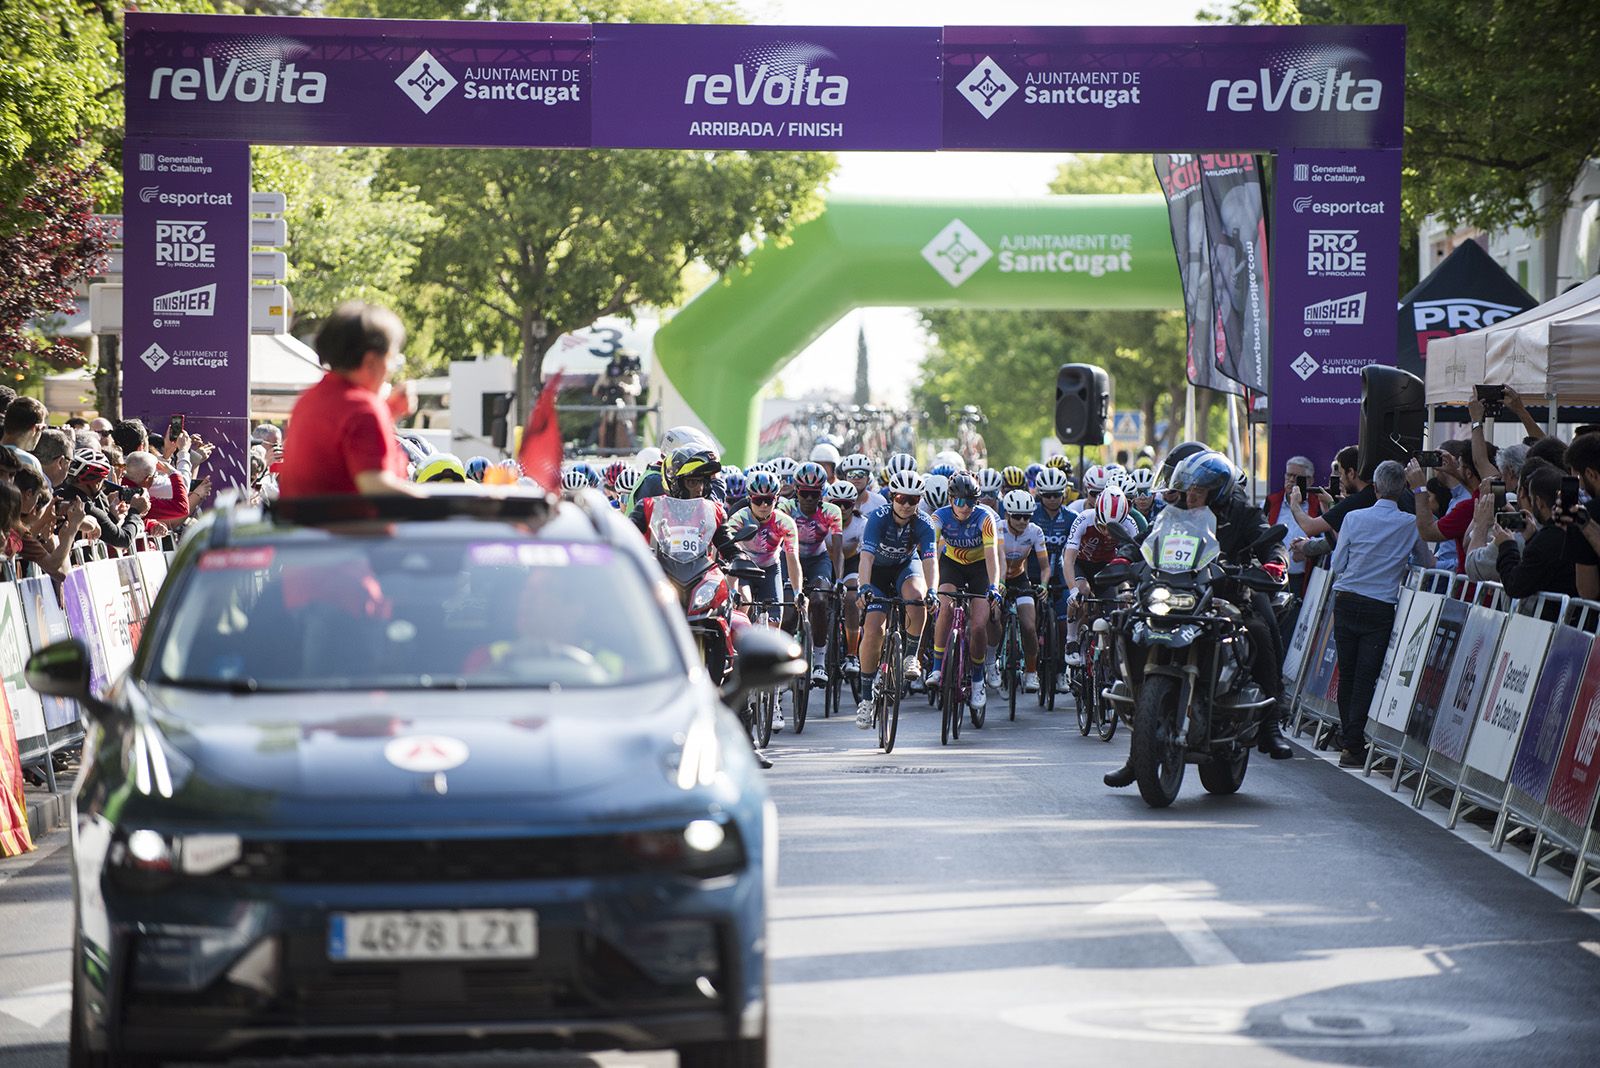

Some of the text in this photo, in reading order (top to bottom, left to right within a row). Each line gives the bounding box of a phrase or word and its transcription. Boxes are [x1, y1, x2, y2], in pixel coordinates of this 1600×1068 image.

[149, 58, 328, 104] reVolta
[464, 67, 580, 82] AJUNTAMENT DE
[1025, 71, 1140, 85] AJUNTAMENT DE
[684, 64, 849, 106] reVolta
[1206, 68, 1383, 112] reVolta
[464, 81, 580, 106] SantCugat
[1024, 85, 1141, 109] SantCugat
[689, 121, 843, 137] ARRIBADA / FINISH
[157, 154, 204, 164] Generalitat
[157, 164, 213, 175] de Catalunya
[1311, 165, 1357, 174] Generalitat
[1311, 173, 1366, 184] de Catalunya
[159, 191, 233, 207] esportcat
[1312, 200, 1385, 216] esportcat
[156, 224, 206, 244] PRO
[999, 234, 1133, 250] AJUNTAMENT DE
[1308, 234, 1358, 252] PRO
[156, 244, 216, 262] RIDE
[998, 250, 1132, 277] SantCugat
[1307, 253, 1367, 271] RIDE
[155, 290, 210, 310] FINISHER
[1306, 299, 1361, 319] FINISHER
[588, 327, 624, 358] 3
[172, 350, 218, 358] AJUNTAMENT
[172, 357, 228, 369] SantCugat
[1322, 366, 1362, 376] SantCu
[151, 387, 216, 397] visitsantcugat.cat
[1300, 396, 1362, 405] visitsantcugat.ca
[682, 538, 698, 552] 96
[1175, 550, 1191, 562] 97
[359, 917, 446, 951] 4678
